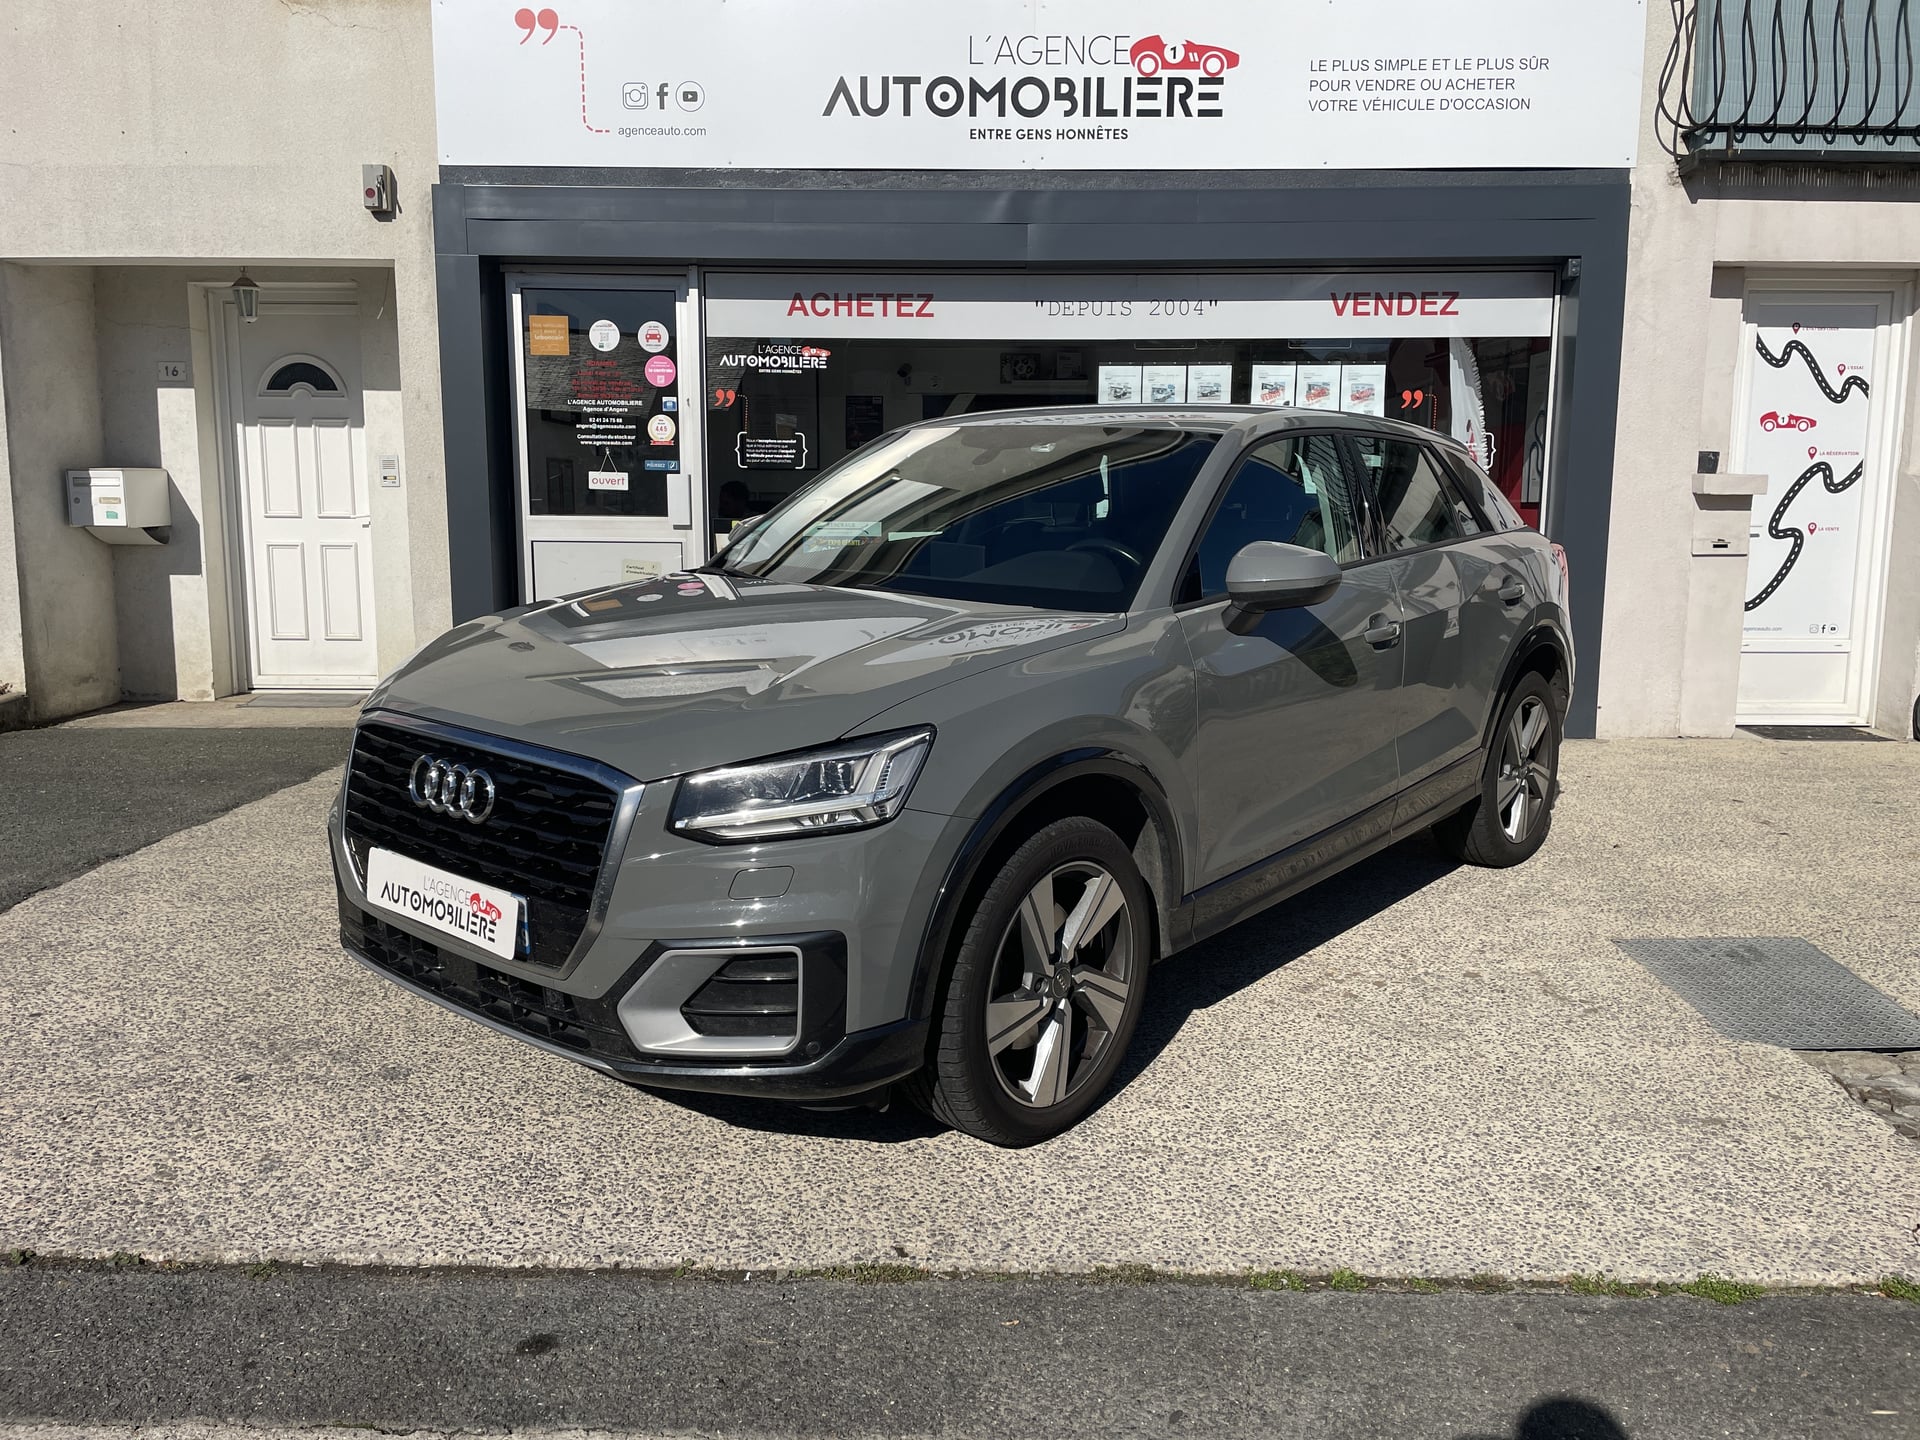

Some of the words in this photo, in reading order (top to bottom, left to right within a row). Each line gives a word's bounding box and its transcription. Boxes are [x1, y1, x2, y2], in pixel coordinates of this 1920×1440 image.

[970, 35, 1130, 65] L'AGENCE
[1310, 60, 1327, 72] LE
[1332, 59, 1369, 71] PLUS
[1374, 59, 1427, 71] SIMPLE
[1432, 59, 1450, 70] ET
[1454, 58, 1472, 70] LE
[1477, 58, 1514, 70] PLUS
[1519, 56, 1550, 70] SÛR
[1310, 80, 1350, 92] POUR
[1355, 79, 1415, 91] VENDRE
[1420, 79, 1442, 91] OU
[1445, 78, 1515, 90] ACHETER
[1309, 100, 1357, 111] VOTRE
[1362, 97, 1435, 111] VÉHICULE
[1440, 98, 1531, 111] D'OCCASION
[618, 126, 706, 138] agenceauto.com
[969, 128, 1012, 140] ENTRE
[1016, 128, 1052, 140] GENS
[1056, 125, 1128, 140] HONNÊTES
[787, 292, 934, 317] ACHETEZ
[1330, 291, 1460, 316] VENDEZ
[758, 345, 802, 354] L'AGENCE
[164, 366, 179, 377] 16
[592, 476, 625, 486] ouvert
[423, 875, 471, 906] L'AGENCE
